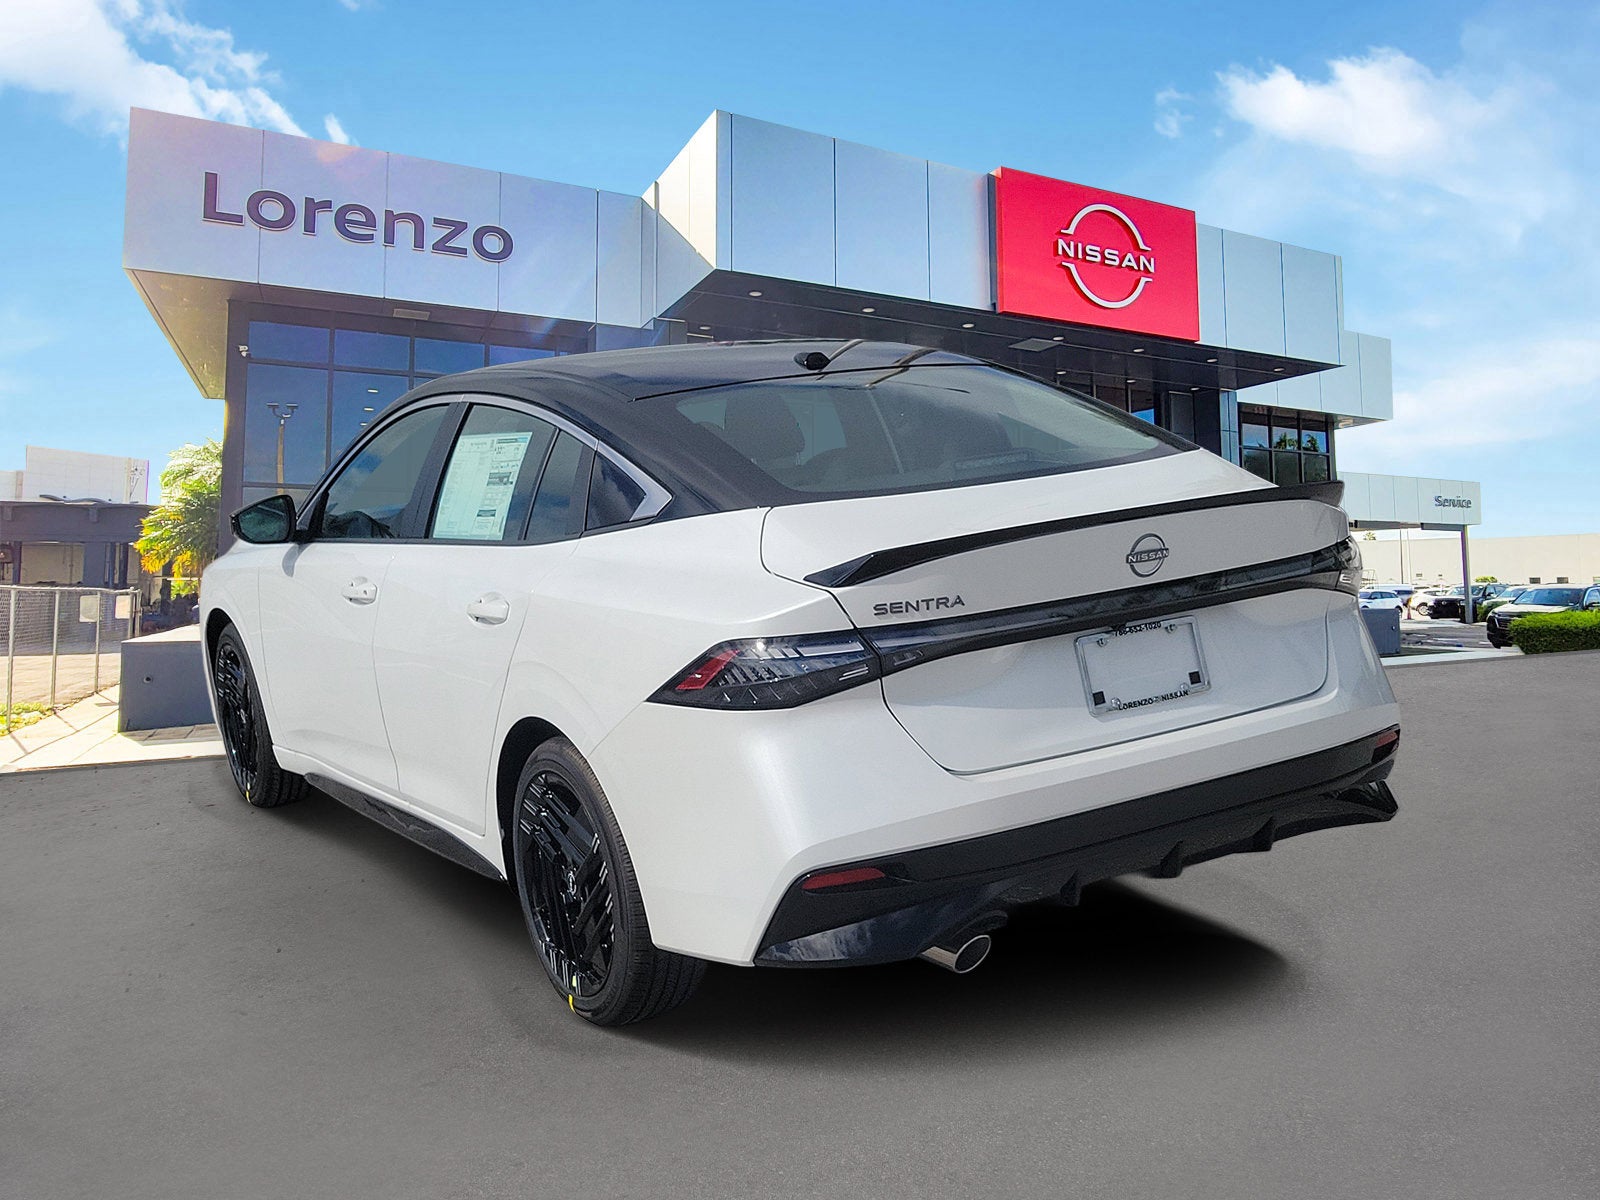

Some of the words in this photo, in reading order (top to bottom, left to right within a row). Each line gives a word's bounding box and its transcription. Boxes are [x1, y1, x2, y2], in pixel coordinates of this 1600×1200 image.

[202, 171, 514, 263] Lorenzo
[1057, 238, 1155, 273] NISSAN
[1434, 495, 1472, 508] Service
[1128, 549, 1169, 563] NISSAN
[873, 594, 965, 616] SENTRA
[1118, 697, 1154, 711] LORENZO
[1161, 690, 1189, 701] NISSAN
